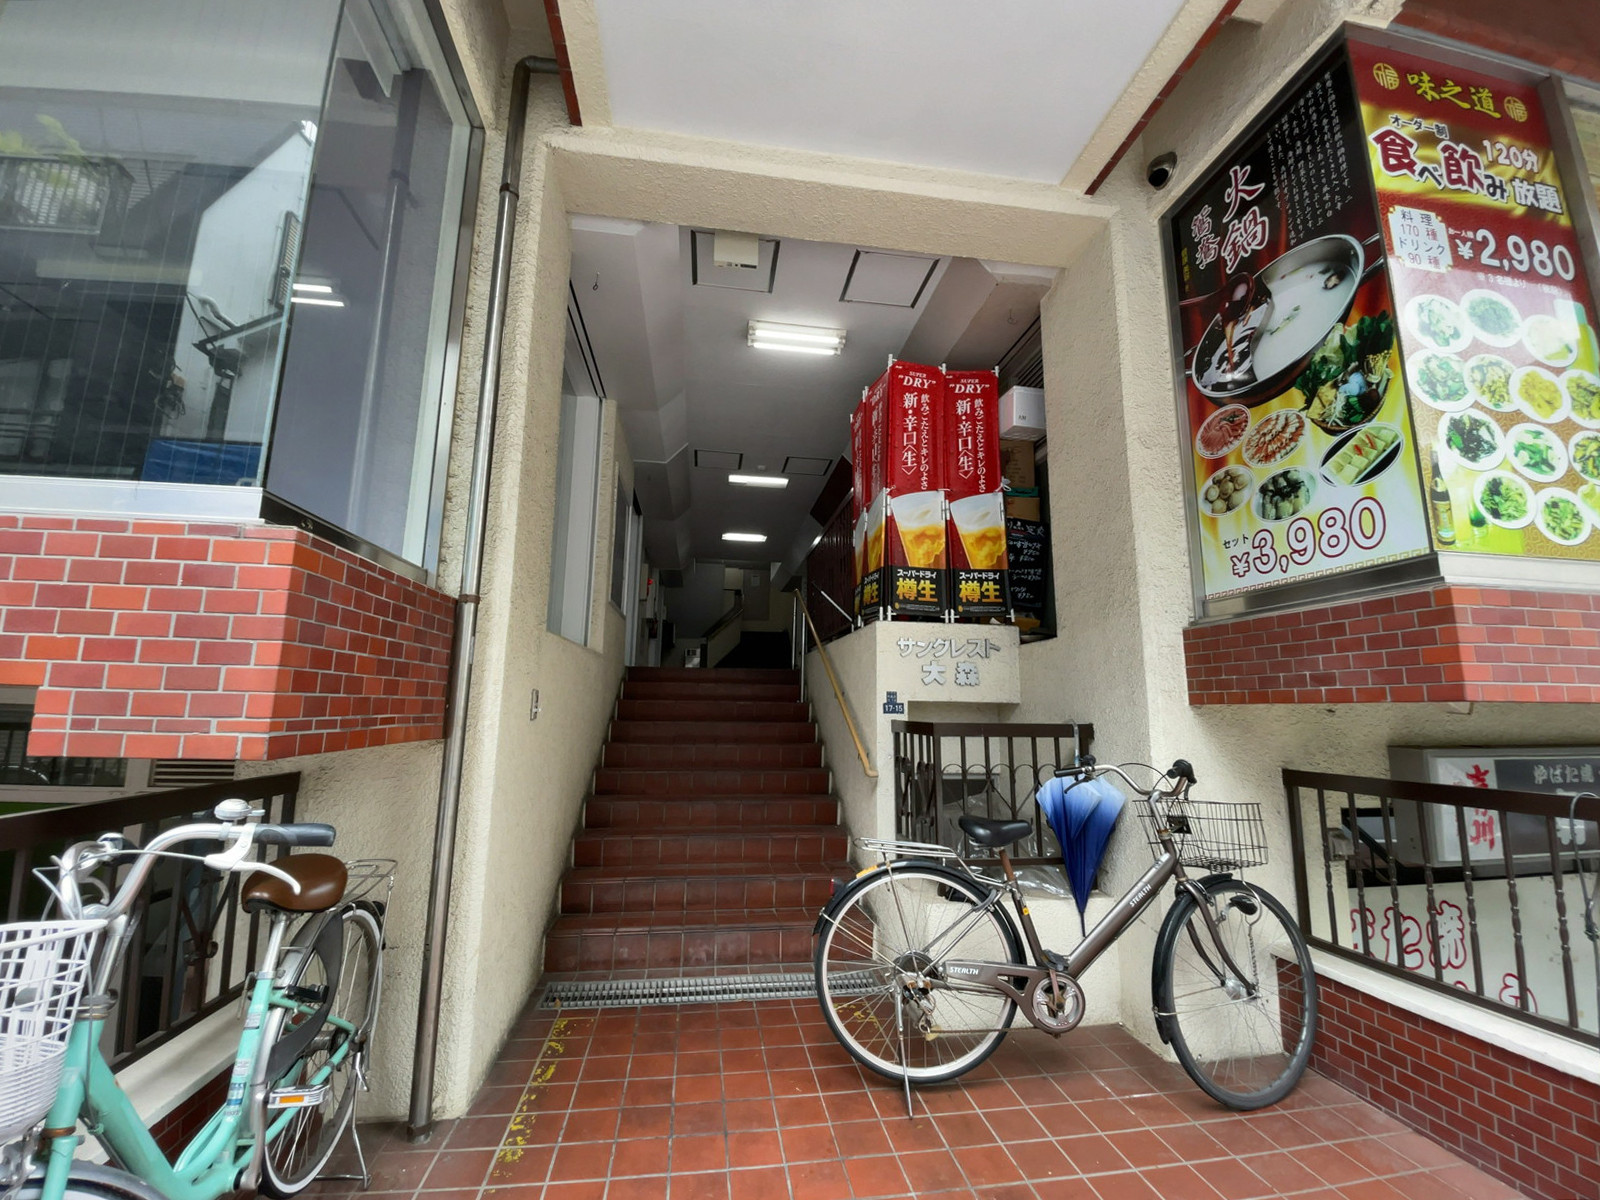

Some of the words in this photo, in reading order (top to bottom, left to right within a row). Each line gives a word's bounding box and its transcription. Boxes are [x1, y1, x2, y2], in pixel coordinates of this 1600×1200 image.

[1406, 71, 1502, 119] 味之道
[1389, 115, 1449, 139] オーダー制
[1483, 139, 1540, 173] 120分
[1400, 237, 1446, 256] ドリンク
[1222, 534, 1249, 549] セット
[1230, 496, 1387, 579] ¥3,980
[897, 569, 937, 579] スーパードライ
[960, 571, 1000, 580] スーパードライ
[896, 578, 938, 602] 樽生
[959, 580, 1003, 603] 樽生
[897, 637, 1001, 659] サンクレスト
[921, 660, 980, 687] 大森
[1129, 883, 1152, 908] STEALTH
[950, 966, 979, 975] STEALTH
